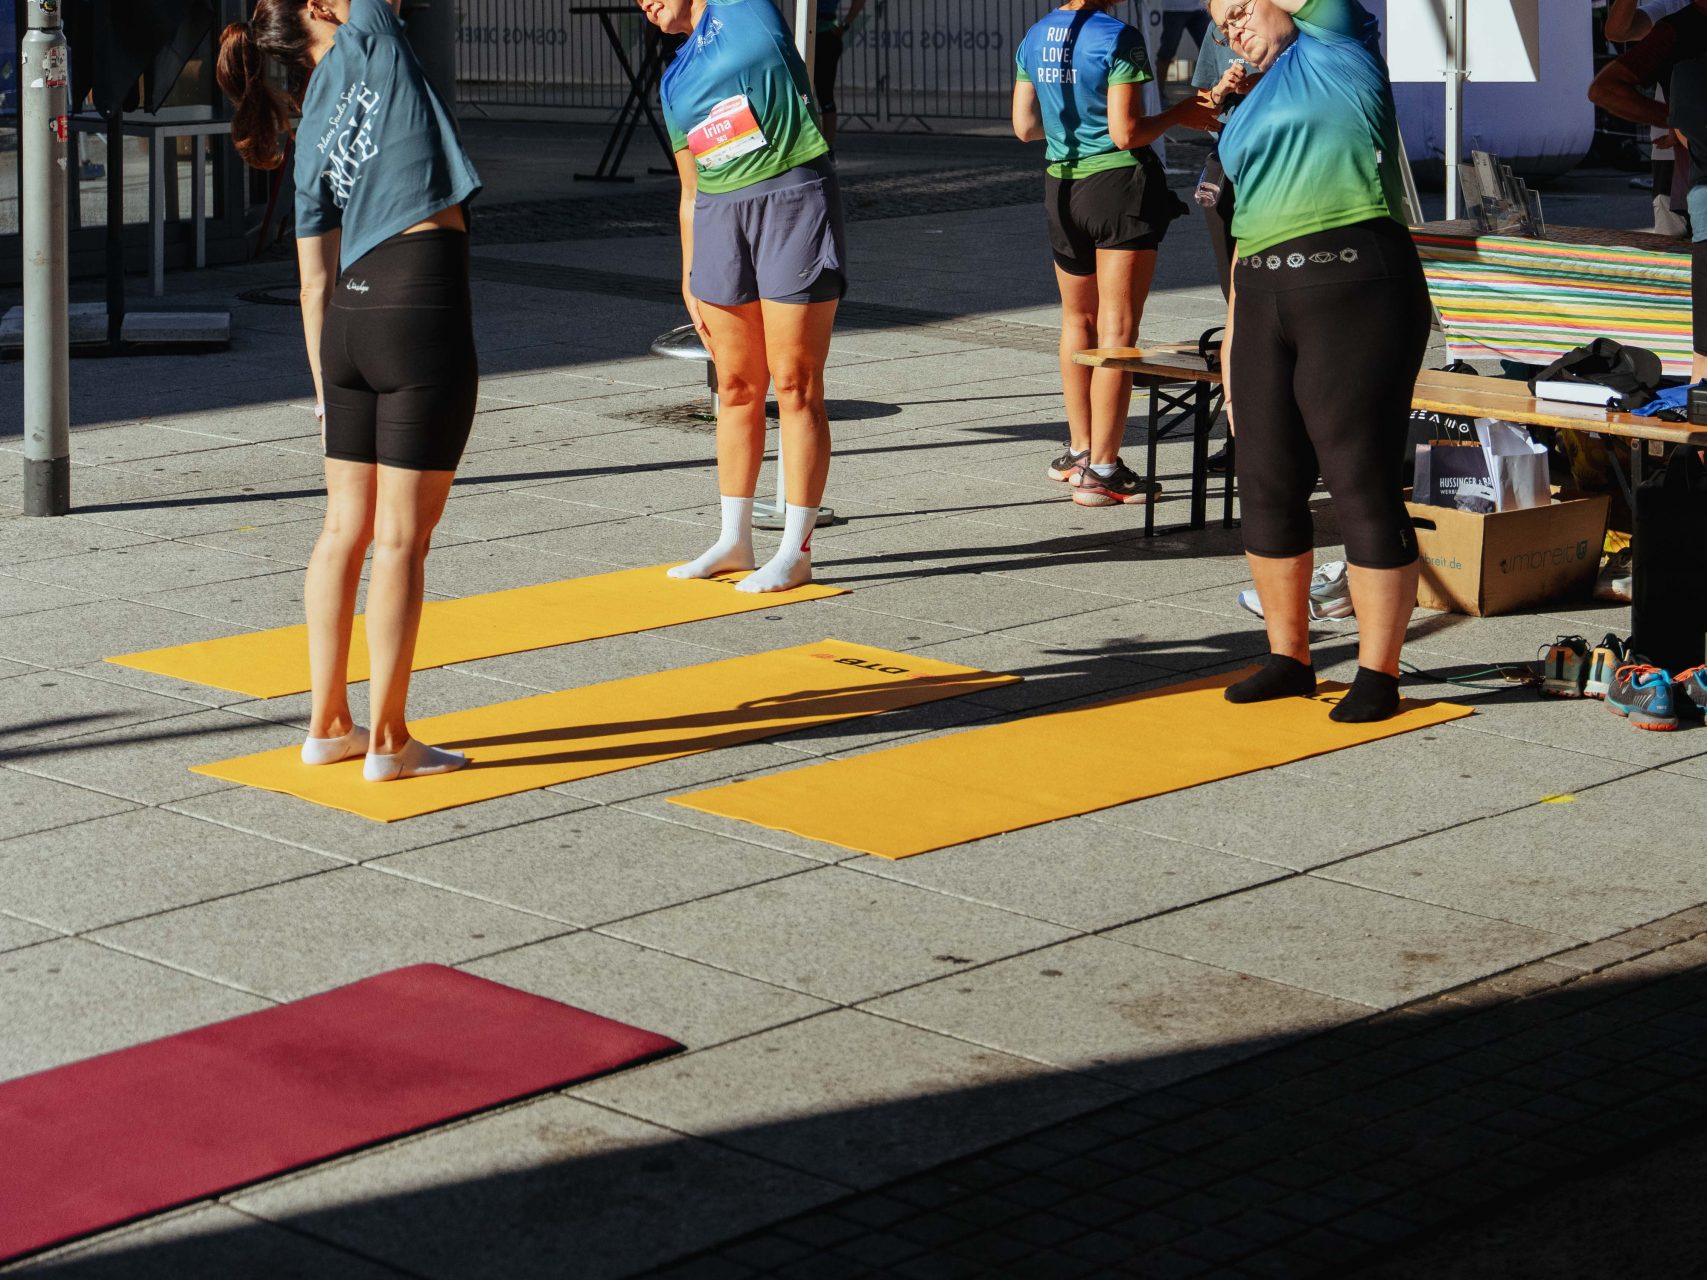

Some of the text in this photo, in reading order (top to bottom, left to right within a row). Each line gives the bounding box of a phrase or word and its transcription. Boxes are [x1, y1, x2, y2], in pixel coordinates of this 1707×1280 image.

[1046, 26, 1073, 45] RUN,
[1042, 46, 1072, 64] LOVE,
[1037, 67, 1078, 85] REPEAT
[328, 102, 347, 129] Studio
[340, 82, 357, 104] Saar
[703, 119, 732, 140] Irina
